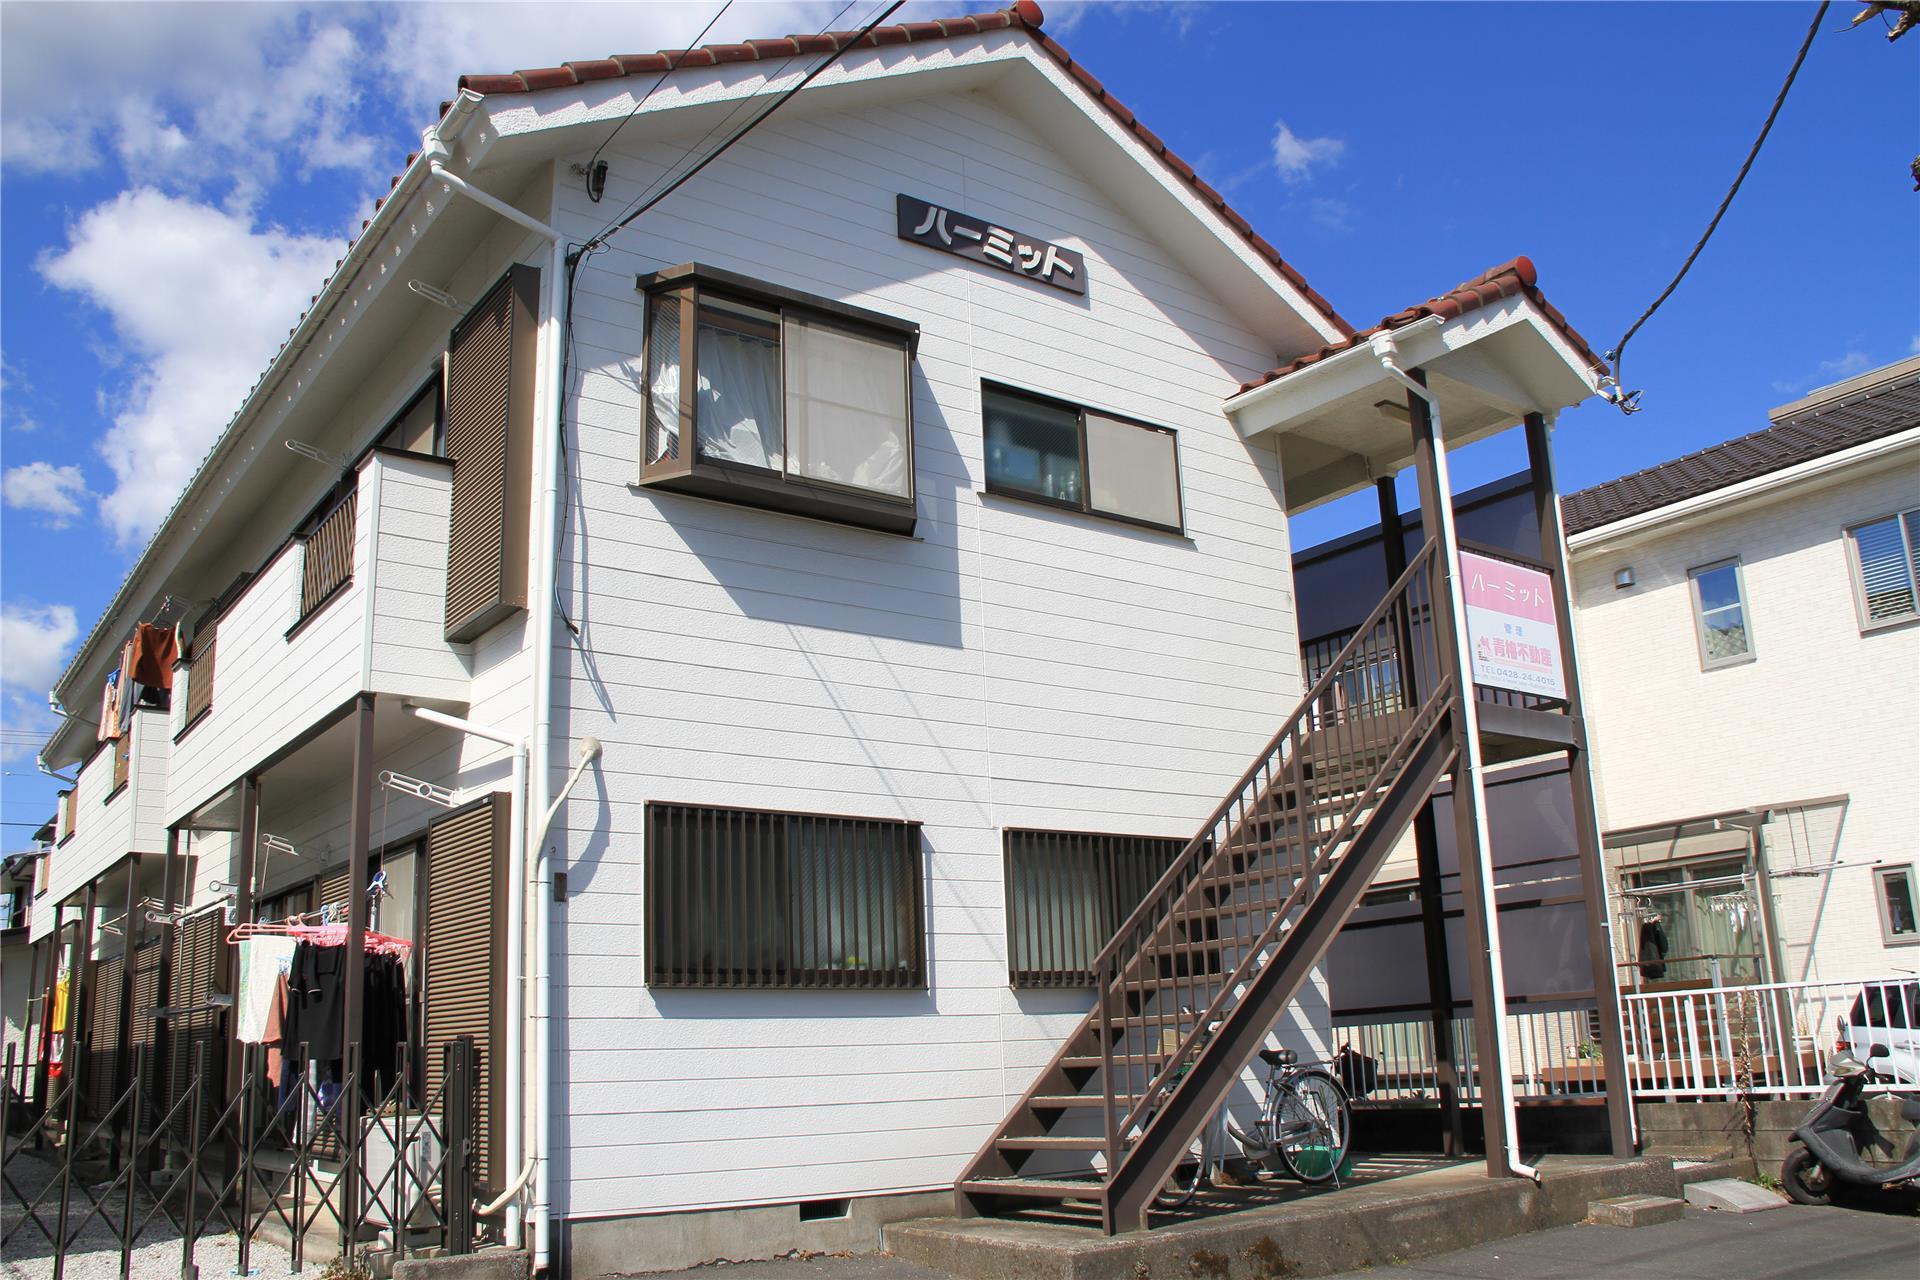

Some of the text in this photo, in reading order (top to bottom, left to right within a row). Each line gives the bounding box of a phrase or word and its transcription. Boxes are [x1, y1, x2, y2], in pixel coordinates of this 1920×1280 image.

[913, 206, 1074, 277] ハーミット
[1471, 573, 1545, 608] ハーミット
[1492, 637, 1553, 667] 青梅不動産
